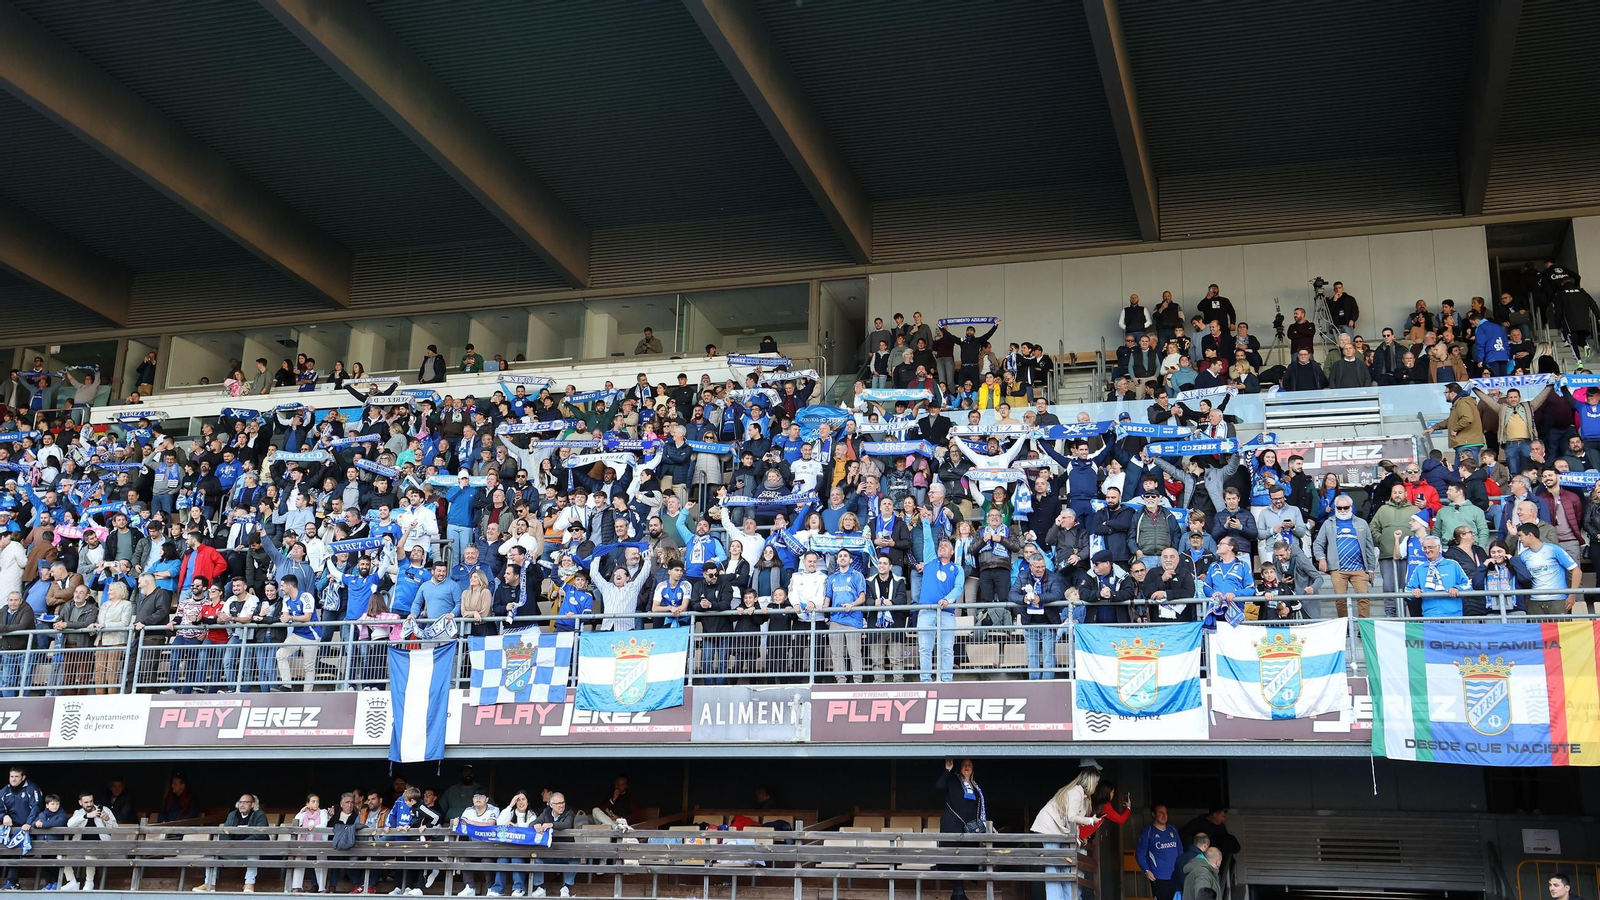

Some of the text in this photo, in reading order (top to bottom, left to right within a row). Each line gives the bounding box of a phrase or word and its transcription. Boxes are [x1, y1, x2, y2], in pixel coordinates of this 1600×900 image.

[510, 376, 542, 384] XEREZ
[1473, 374, 1547, 388] XEREZ
[1181, 387, 1220, 399] XEREZ
[121, 411, 142, 419] XEREZ
[966, 424, 1013, 433] XEREZ
[688, 442, 708, 450] XEREZ
[877, 442, 908, 451] XEREZ
[1192, 443, 1217, 451] XEREZ
[334, 540, 364, 552] XEREZ
[1405, 639, 1562, 650] MI GRAN FAMILIA
[1267, 661, 1298, 695] XEREZ
[1472, 681, 1506, 721] XEREZ
[474, 704, 557, 726] PLAY
[826, 699, 919, 723] PLAY
[85, 713, 140, 722] Ayuntamiento
[160, 707, 235, 729] PLAY
[84, 722, 114, 731] de Jerez
[942, 723, 982, 731] EXPLORA,
[1405, 738, 1582, 754] DESDE QUE NACISTE
